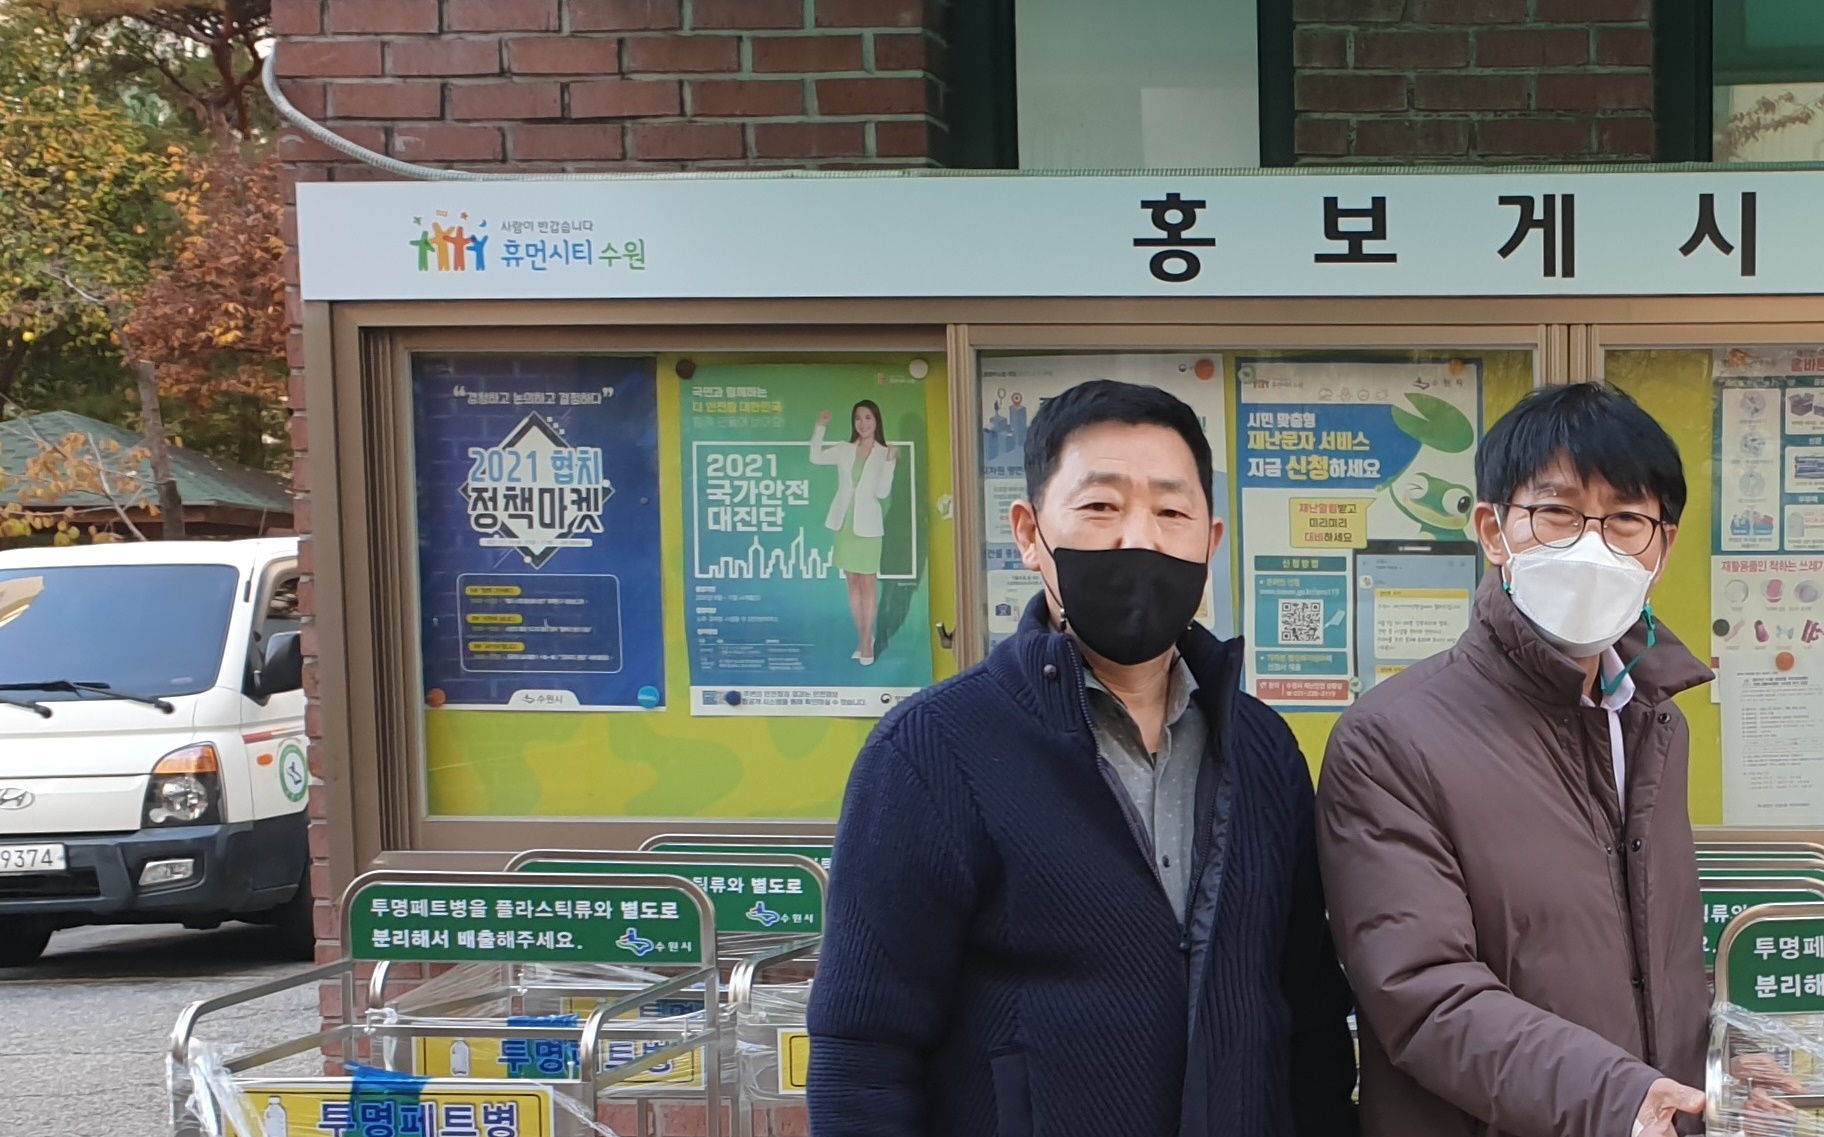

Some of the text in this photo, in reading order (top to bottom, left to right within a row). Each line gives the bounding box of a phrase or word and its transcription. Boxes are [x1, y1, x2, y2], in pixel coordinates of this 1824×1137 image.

[501, 220, 594, 235] 사람이 반갑습니다
[501, 238, 646, 271] 휴먼시티 수원
[1247, 412, 1317, 429] 시민 맞춤형
[1247, 431, 1371, 451] 재난문자 서비스
[469, 449, 601, 486] 2021 협치
[706, 454, 777, 478] 2021
[1247, 454, 1382, 481] 지금 신청하세요
[706, 480, 810, 506] 국가안전
[469, 485, 603, 532] 정책마켓
[707, 506, 785, 532] 대진단
[537, 692, 564, 705] 수원시
[751, 877, 804, 895] 별도로
[370, 898, 680, 920] 투명페트병을 플라스틱류와 별도로
[780, 913, 814, 924] 수원시
[371, 928, 583, 950] 분리해서 배출해주세요.
[654, 941, 693, 953] 수원시
